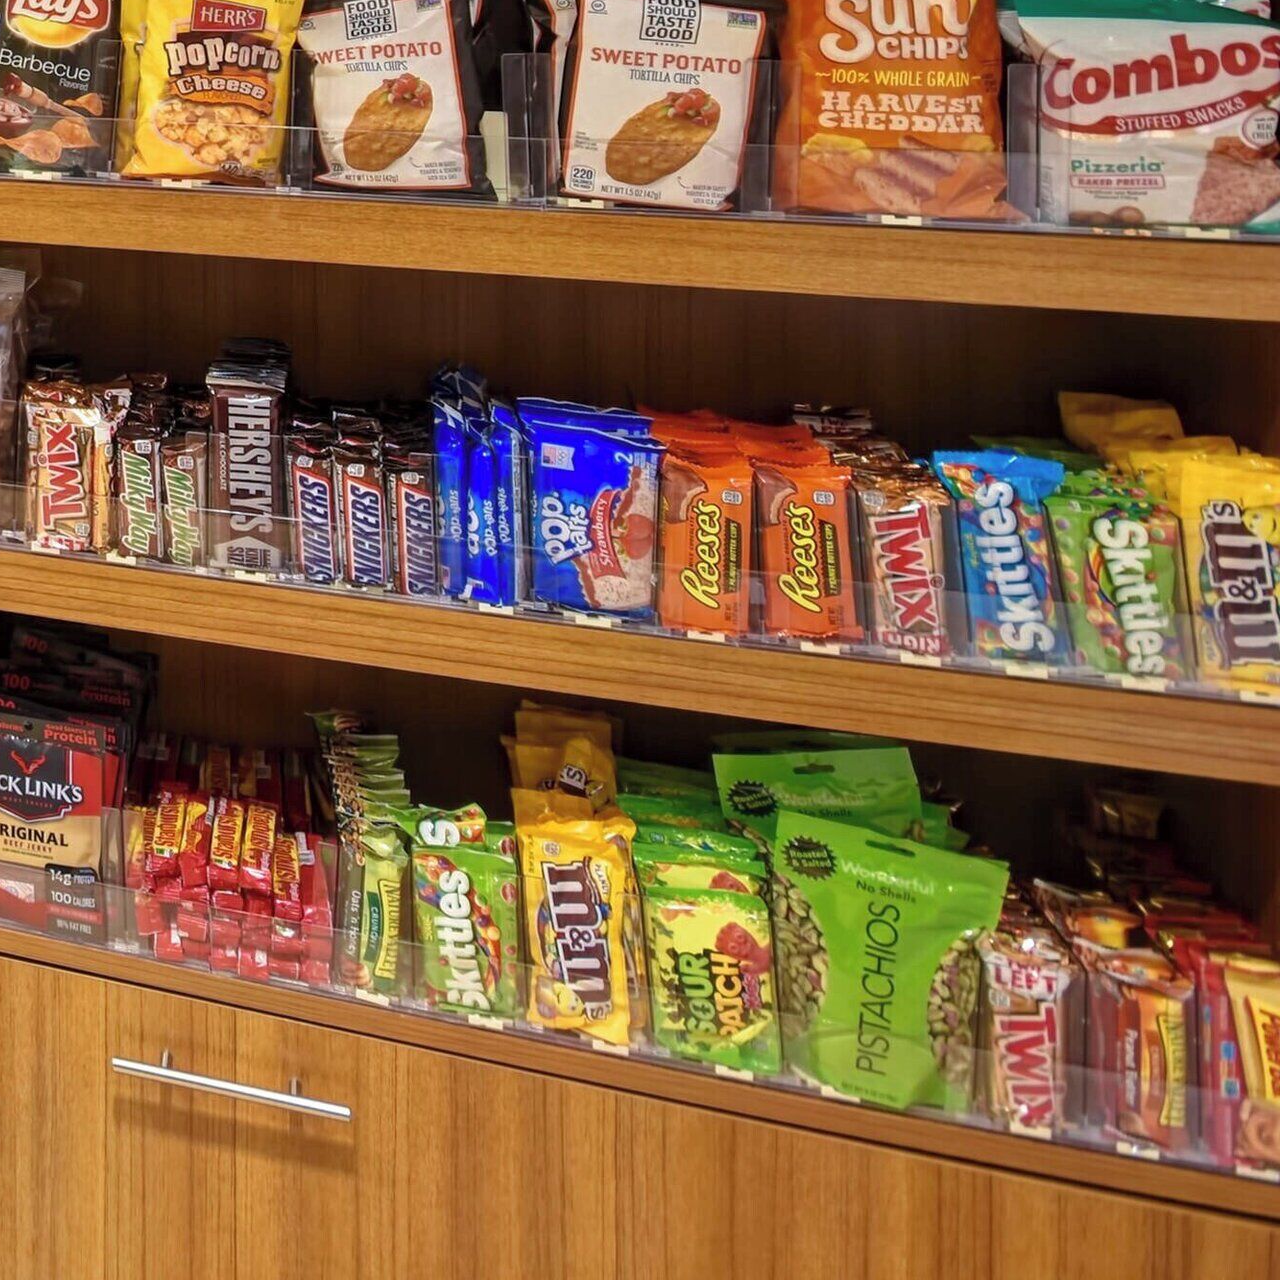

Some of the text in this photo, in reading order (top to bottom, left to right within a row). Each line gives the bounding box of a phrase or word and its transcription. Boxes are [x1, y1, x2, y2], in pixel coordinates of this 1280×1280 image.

[199, 6, 256, 27] HERR'S
[349, 7, 391, 20] SHOULD
[647, 5, 697, 18] SHOULD
[349, 17, 392, 30] TASTE
[350, 24, 393, 38] GOOD
[645, 26, 693, 40] GOOD
[647, 15, 695, 30] TASTE
[371, 42, 442, 59] POTATO
[877, 36, 968, 60] CHIPS
[345, 60, 408, 73] TORTILLA CHIPS
[591, 47, 742, 75] SWEET POTATO
[630, 69, 700, 85] TORTILLA CHIPS
[831, 69, 970, 88] 100% WHOLE GRAIN
[1044, 34, 1280, 110] Combos
[59, 78, 89, 91] Flavored
[176, 74, 266, 100] Cheese
[821, 90, 983, 114] HARVEST
[818, 112, 984, 133] CHEDDAR
[1115, 96, 1246, 133] STUFFED SNACKS
[573, 168, 593, 180] 220
[1070, 156, 1163, 173] Pizzeria
[601, 184, 613, 194] NET
[1078, 177, 1160, 186] BAKED PRETZEL
[227, 397, 273, 533] HERSHEY'S
[298, 475, 333, 585] SNICKERS
[350, 484, 384, 585] SNICKERS
[593, 497, 614, 568] Strawberry
[404, 491, 436, 595] SNICKERS
[680, 500, 722, 609] Reese's
[778, 503, 823, 614] Reese's
[1093, 518, 1169, 674] Skittles
[43, 729, 98, 747] Protein
[25, 779, 83, 804] LINK'S
[3, 838, 24, 848] BEEF
[789, 848, 829, 860] Roasted
[50, 869, 72, 886] 14g
[50, 890, 96, 908] 100 CALORIES
[351, 890, 361, 912] Oats
[856, 879, 917, 905] No Shells
[347, 926, 359, 957] Honey
[856, 901, 901, 1076] PISTACHIOS
[995, 969, 1057, 993] LEFT
[678, 953, 716, 1036] SOUR
